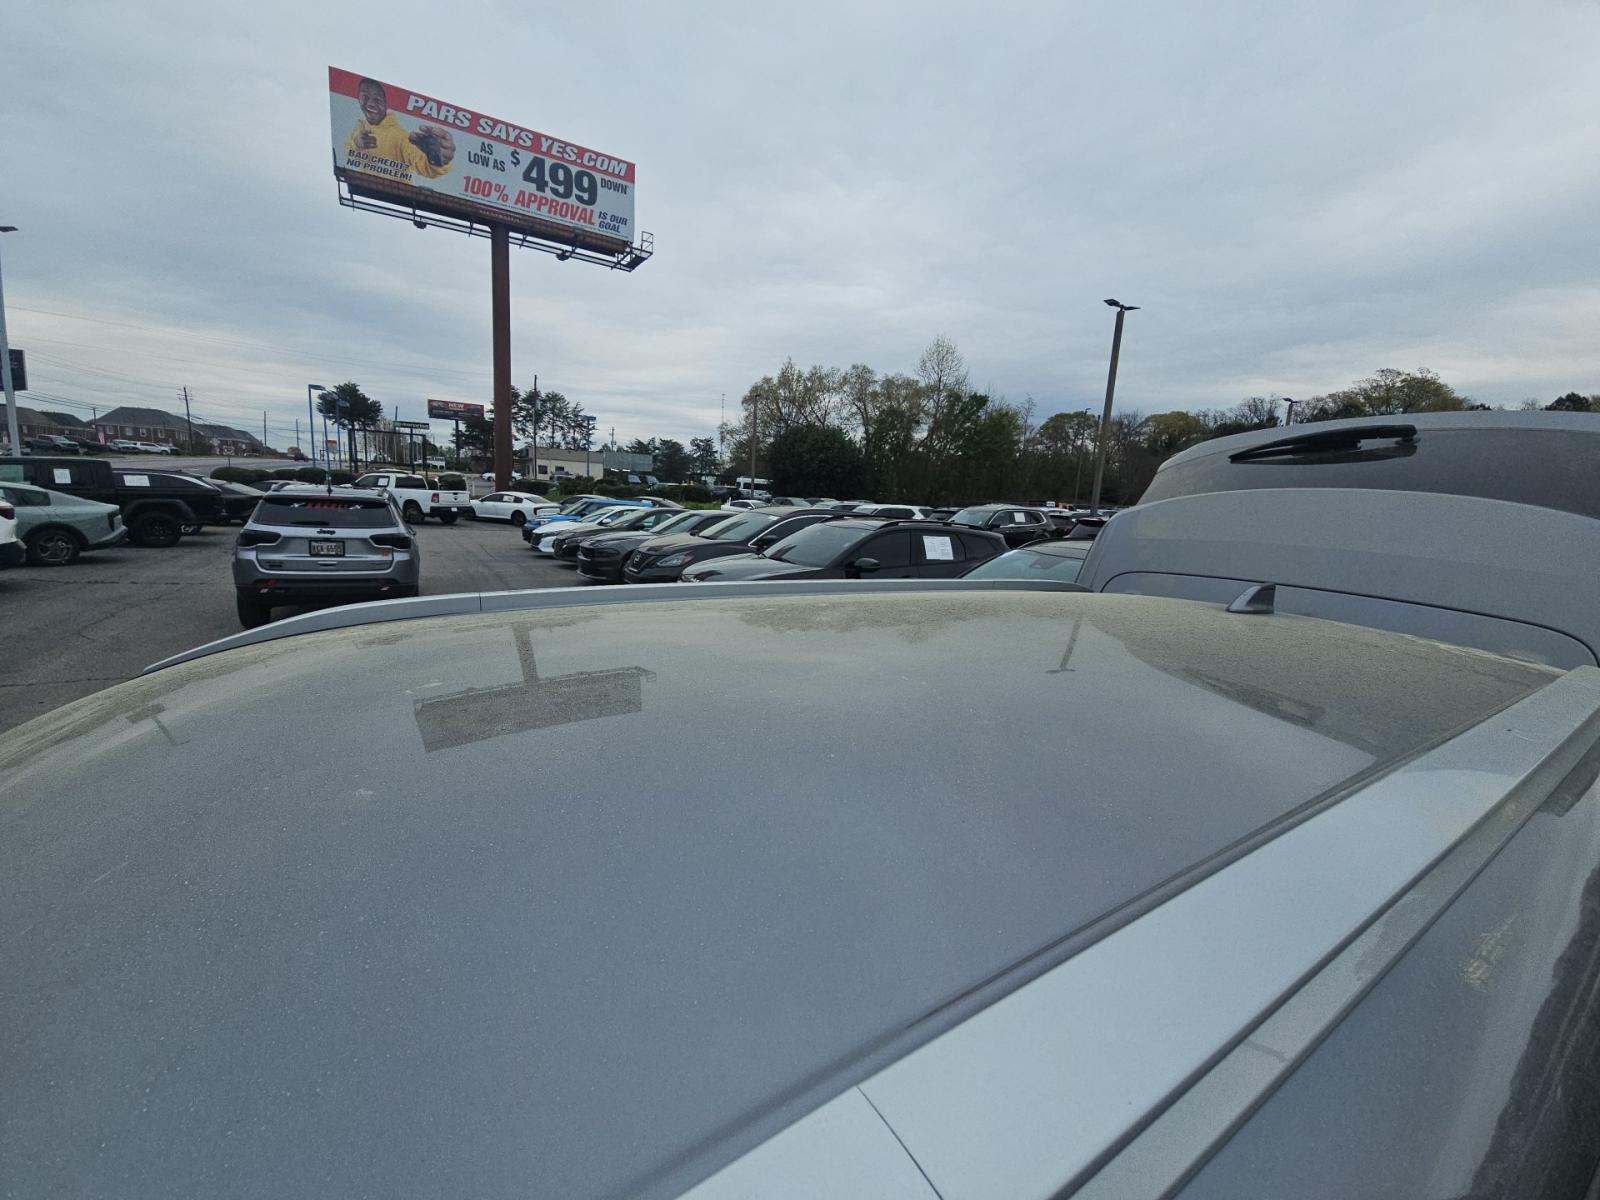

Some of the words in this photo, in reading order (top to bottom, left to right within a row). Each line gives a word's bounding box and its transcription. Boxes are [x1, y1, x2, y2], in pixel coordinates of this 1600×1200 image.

[406, 95, 472, 128] PARS
[476, 117, 534, 147] SAYS
[540, 136, 628, 177] YES.COM
[480, 141, 494, 156] AS
[346, 158, 361, 168] NO
[363, 161, 413, 182] PROBLEM!
[348, 149, 369, 161] BAD
[371, 155, 410, 172] CREDIT?
[468, 151, 490, 168] LOW
[492, 158, 506, 172] AS
[600, 177, 627, 195] DOWN
[463, 175, 509, 203] 100%
[514, 190, 595, 226] APPROVAL
[598, 211, 608, 220] IS
[610, 214, 628, 226] OUR
[598, 221, 621, 234] GOAL
